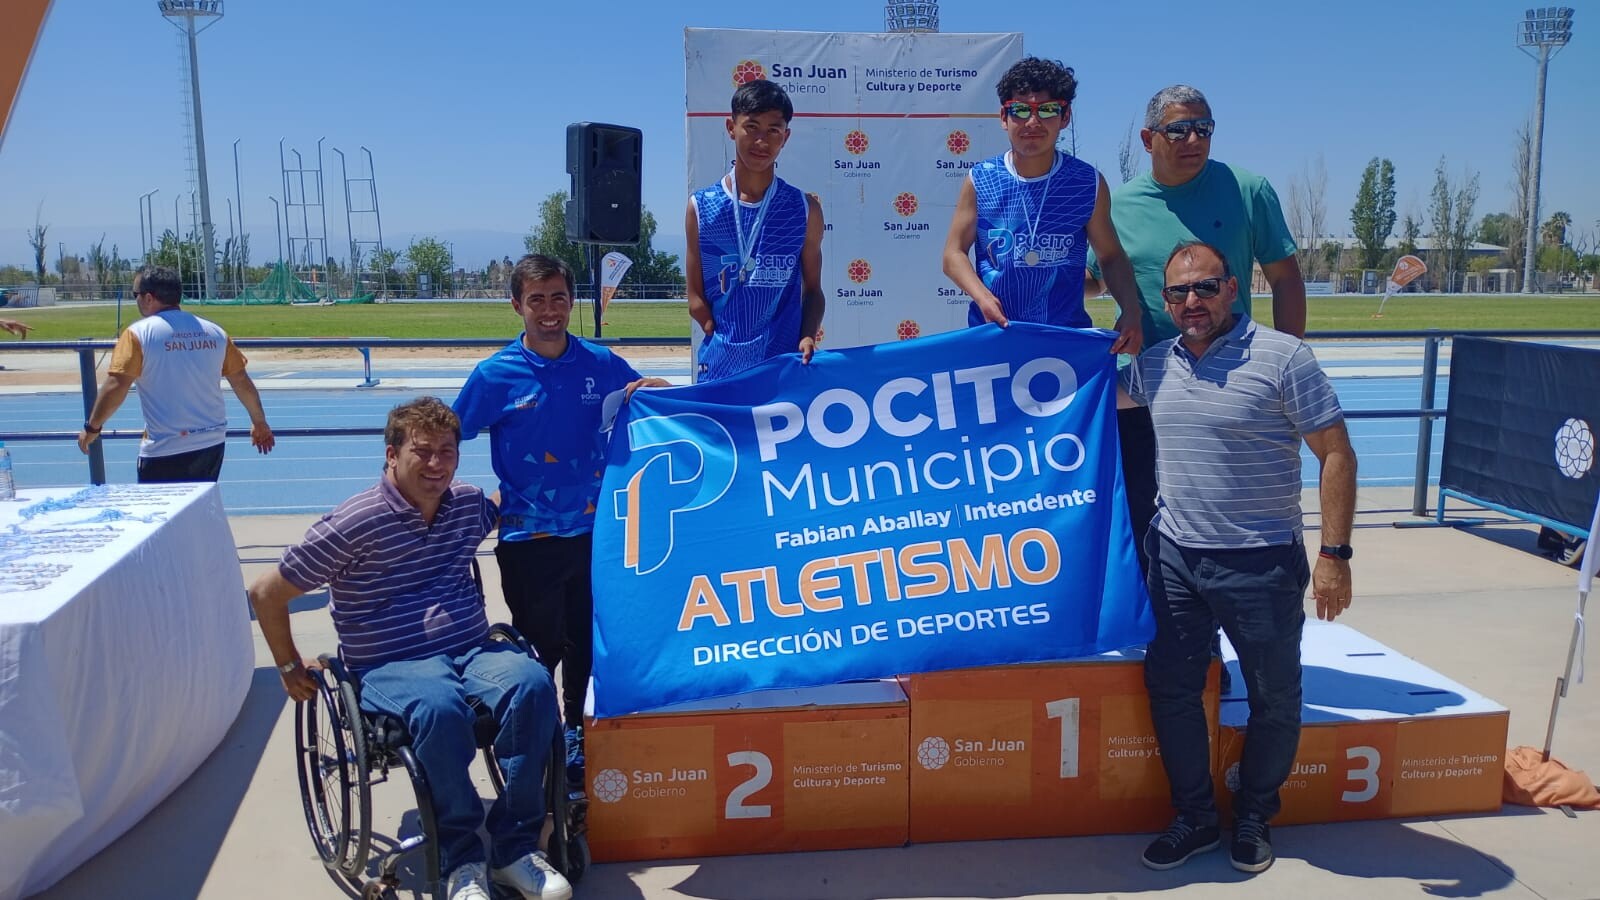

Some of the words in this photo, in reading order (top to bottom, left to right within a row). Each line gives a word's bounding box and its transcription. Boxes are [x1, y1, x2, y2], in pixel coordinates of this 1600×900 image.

[772, 63, 802, 78] San
[808, 65, 847, 79] Juan
[866, 67, 917, 79] Ministerio
[920, 67, 933, 78] de
[936, 68, 978, 78] Turismo
[782, 81, 826, 94] obierno
[866, 81, 905, 92] Cultura
[908, 83, 915, 93] y
[918, 82, 962, 92] Deporte
[834, 160, 854, 169] San
[856, 160, 880, 169] Juan
[936, 160, 955, 169] San
[884, 221, 903, 231] San
[905, 221, 930, 231] Juan
[1015, 234, 1074, 249] POCITO
[755, 254, 796, 268] OCITO
[837, 288, 856, 297] San
[858, 288, 882, 297] Juan
[938, 287, 955, 296] San
[164, 341, 186, 351] SAN
[189, 340, 217, 351] JUAN
[752, 357, 1078, 463] POCITO
[761, 426, 1086, 517] Municipio
[775, 524, 856, 550] Fabian
[861, 508, 952, 536] Aballay
[965, 487, 1097, 522] Intendente
[677, 527, 1062, 632] ATLETISMO
[693, 626, 842, 666] DIRECCIÓN
[850, 621, 888, 646] DE
[898, 603, 1051, 639] DEPORTES
[1045, 697, 1080, 779] 1
[1108, 735, 1155, 745] Ministerio
[954, 739, 984, 752] San
[987, 738, 1025, 752] Juan
[1107, 748, 1145, 758] Cultura
[1146, 748, 1153, 758] y
[954, 755, 1005, 767] Gobierno
[1402, 758, 1447, 768] Ministerio
[1449, 757, 1460, 765] de
[1462, 754, 1498, 764] Turismo
[793, 765, 845, 776] Ministerio
[846, 763, 858, 773] de
[861, 762, 902, 773] Turismo
[1291, 762, 1327, 775] Juan
[1341, 746, 1381, 803] 3
[1401, 770, 1436, 780] Cultura
[1437, 770, 1444, 780] y
[1445, 767, 1483, 778] Deporte
[632, 770, 663, 784] San
[668, 767, 707, 783] Juan
[793, 777, 832, 789] Cultura
[834, 777, 841, 788] y
[843, 775, 886, 787] Deporte
[725, 750, 773, 819] 2
[1283, 780, 1307, 789] erno
[632, 786, 687, 799] Gobierno
